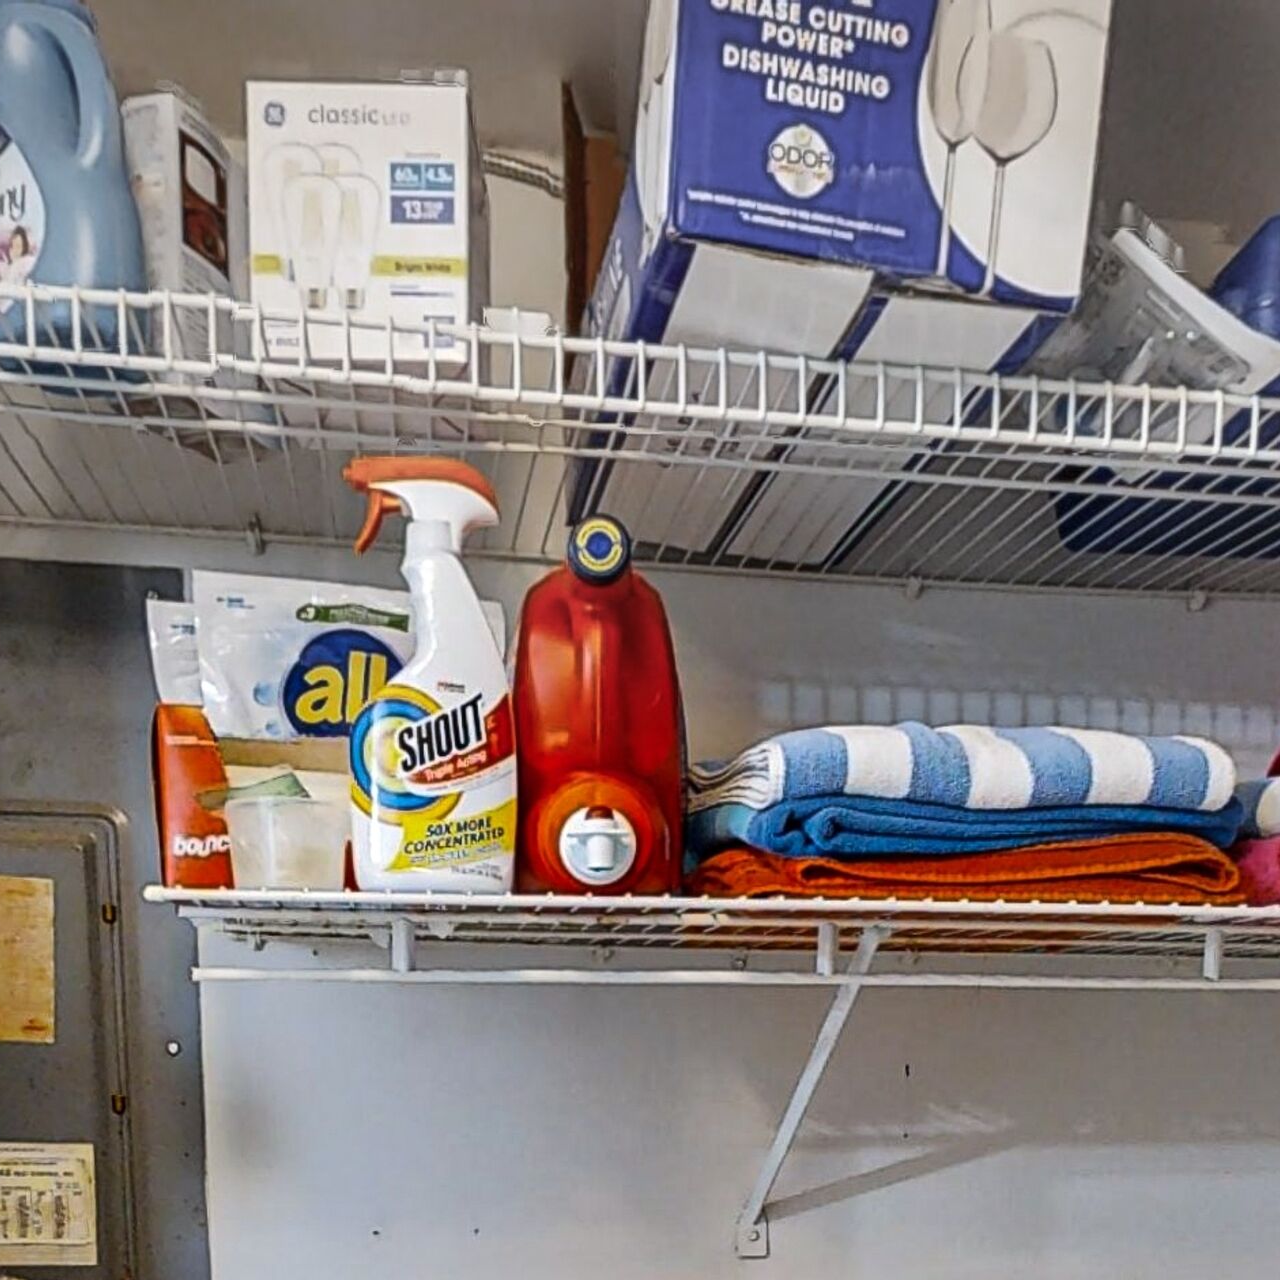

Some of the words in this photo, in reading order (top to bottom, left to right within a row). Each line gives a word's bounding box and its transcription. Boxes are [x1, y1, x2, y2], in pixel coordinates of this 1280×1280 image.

[808, 6, 910, 47] CUTTING
[722, 43, 891, 99] DISHWASHING
[765, 78, 846, 114] LIQUID
[308, 103, 379, 125] classic
[771, 144, 834, 170] ODOR
[294, 650, 387, 725] all
[398, 692, 483, 772] SHOUT
[403, 826, 505, 855] CONCENTRATED
[456, 815, 492, 834] MORE
[173, 833, 231, 858] bounc
